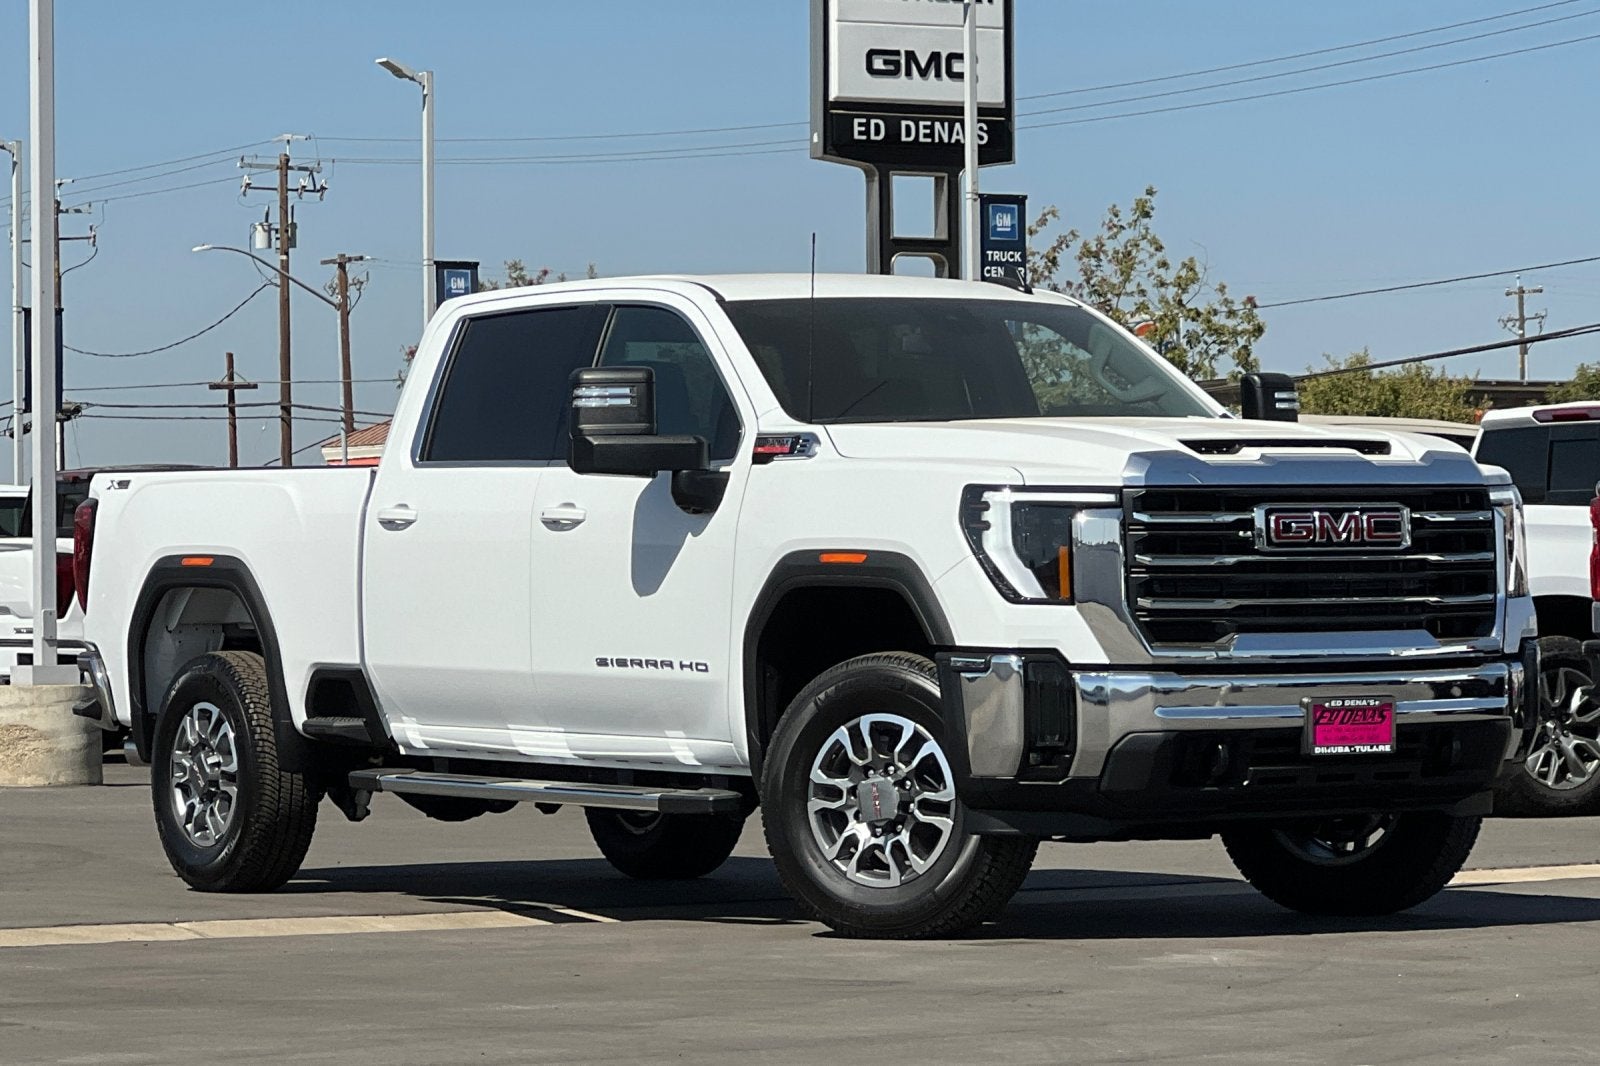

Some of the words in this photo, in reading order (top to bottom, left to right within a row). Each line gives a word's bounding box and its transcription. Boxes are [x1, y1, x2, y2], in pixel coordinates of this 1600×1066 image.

[866, 48, 977, 80] GMC
[853, 118, 886, 140] ED
[901, 120, 989, 144] DENAS
[996, 213, 1011, 227] GM
[986, 250, 1022, 262] TRUCK
[983, 266, 1025, 277] CENR
[451, 277, 465, 289] GM
[1270, 512, 1402, 543] GMC
[595, 657, 675, 670] SIERRA
[679, 660, 709, 673] HD
